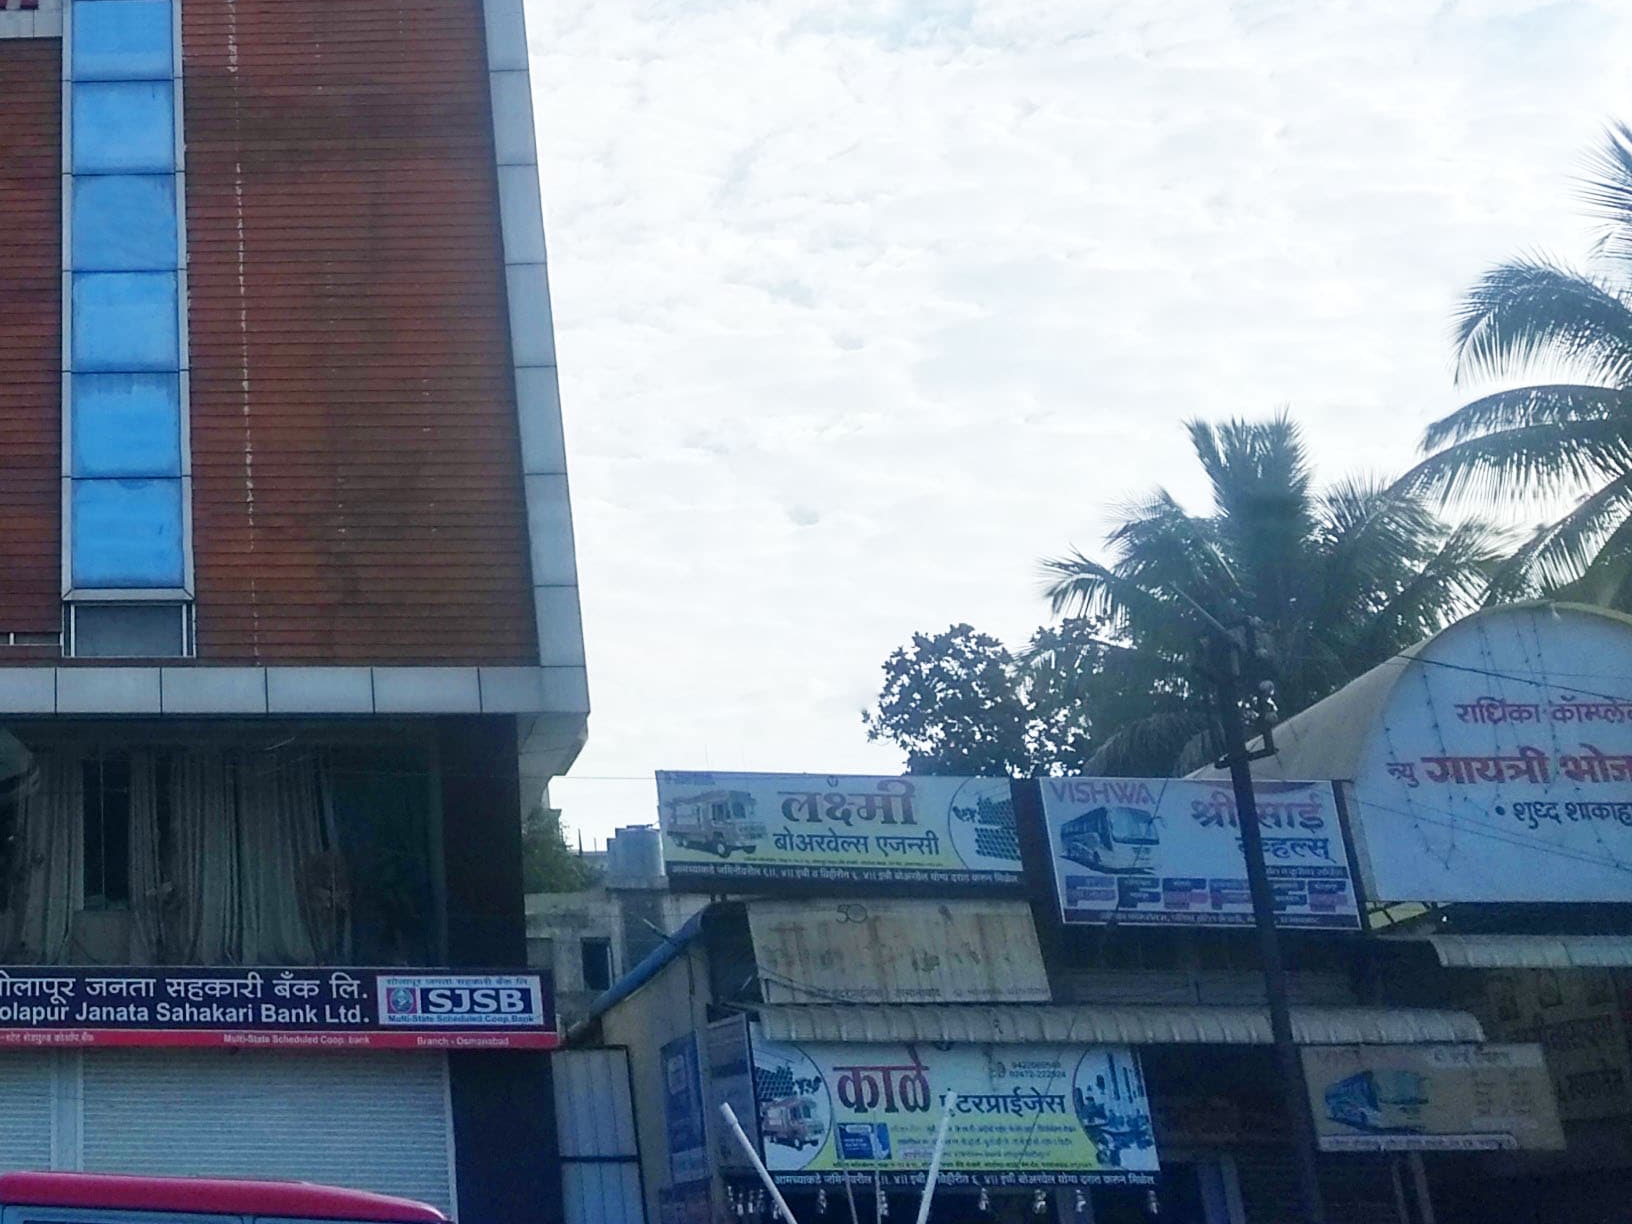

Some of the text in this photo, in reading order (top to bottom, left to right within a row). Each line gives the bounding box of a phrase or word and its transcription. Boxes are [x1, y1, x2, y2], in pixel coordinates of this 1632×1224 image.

[1455, 694, 1632, 724] राधिका कॉम्प्ले
[1421, 746, 1551, 785] गायत्री
[777, 779, 918, 826] लक्ष्मी
[1050, 781, 1156, 805] VISHWA
[773, 826, 940, 857] बोअरवेल्स एजन्सी
[84, 977, 156, 997] जनता
[165, 971, 264, 1001] सहकारी
[329, 972, 368, 999] लि.
[428, 989, 524, 1013] SJSB
[75, 1002, 149, 1021] Janata
[156, 1002, 253, 1022] Sahakari
[261, 1004, 318, 1023] Bank
[325, 1004, 369, 1023] Ltd.
[417, 1036, 449, 1046] Branch
[833, 1044, 931, 1114] काळे
